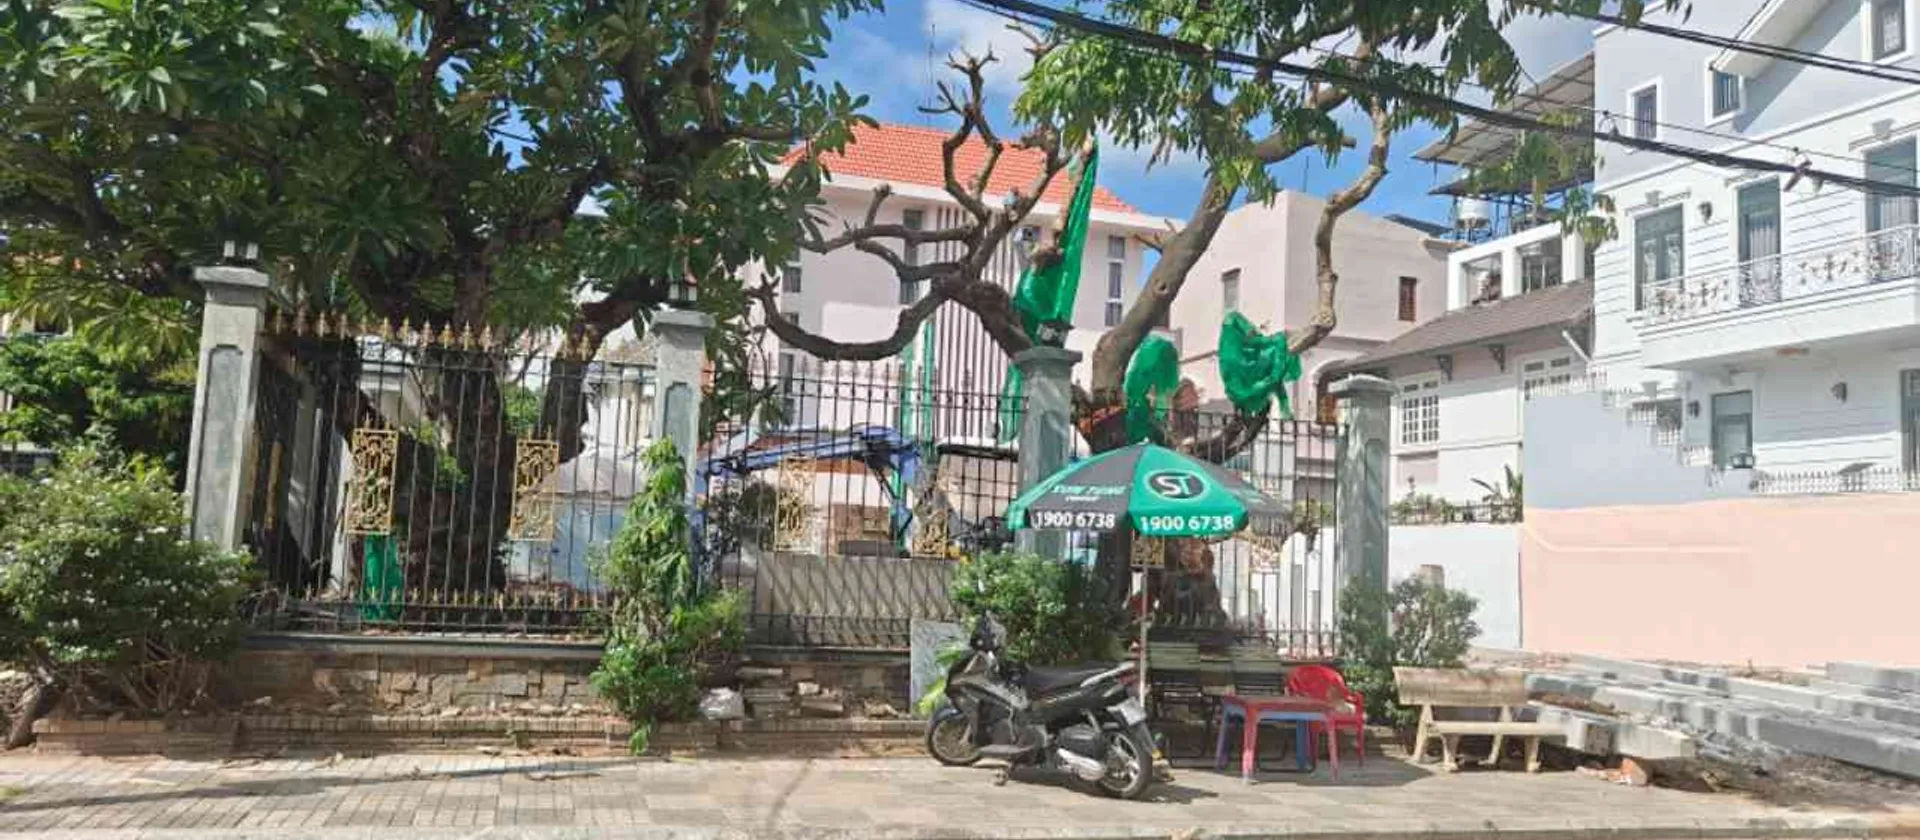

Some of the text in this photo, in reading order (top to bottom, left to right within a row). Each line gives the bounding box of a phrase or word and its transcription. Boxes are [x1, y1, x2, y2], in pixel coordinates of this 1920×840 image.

[1155, 474, 1193, 496] ST
[1036, 510, 1116, 529] 1900 6738
[1140, 515, 1235, 533] 1900 6738
